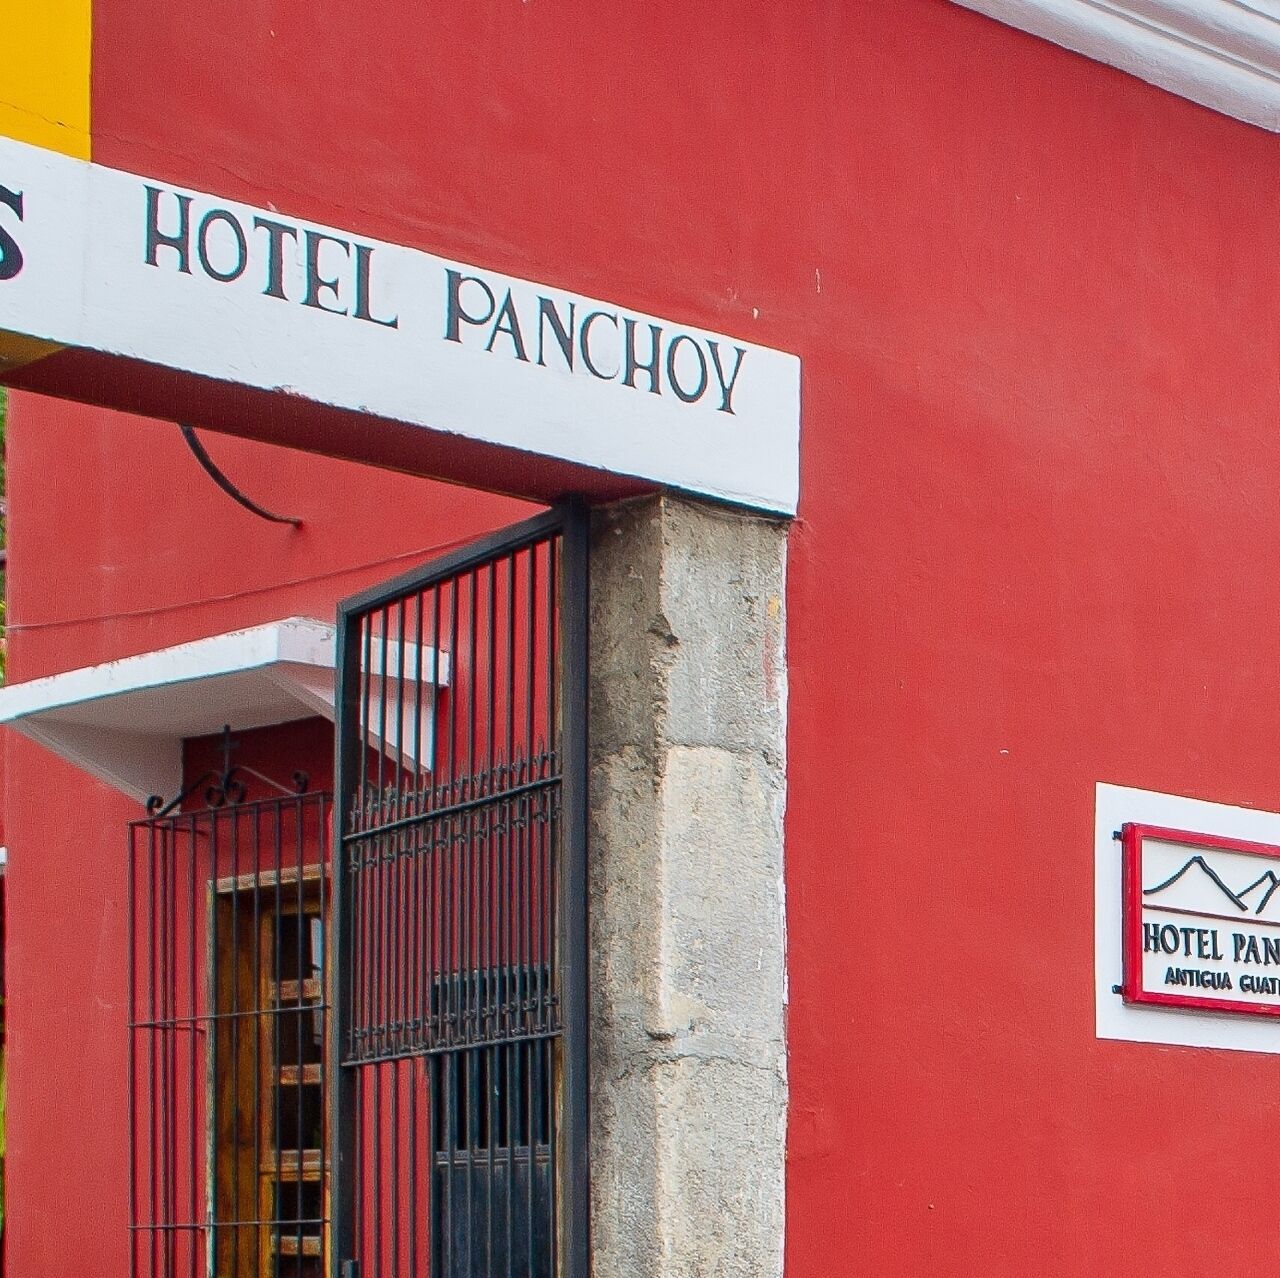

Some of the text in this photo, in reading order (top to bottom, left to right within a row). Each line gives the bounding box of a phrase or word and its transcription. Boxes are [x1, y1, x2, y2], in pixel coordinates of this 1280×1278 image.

[144, 185, 748, 415] HOTEL PANCHOY
[1143, 922, 1224, 961] HOTEL
[1164, 966, 1232, 990] ANTIGUA
